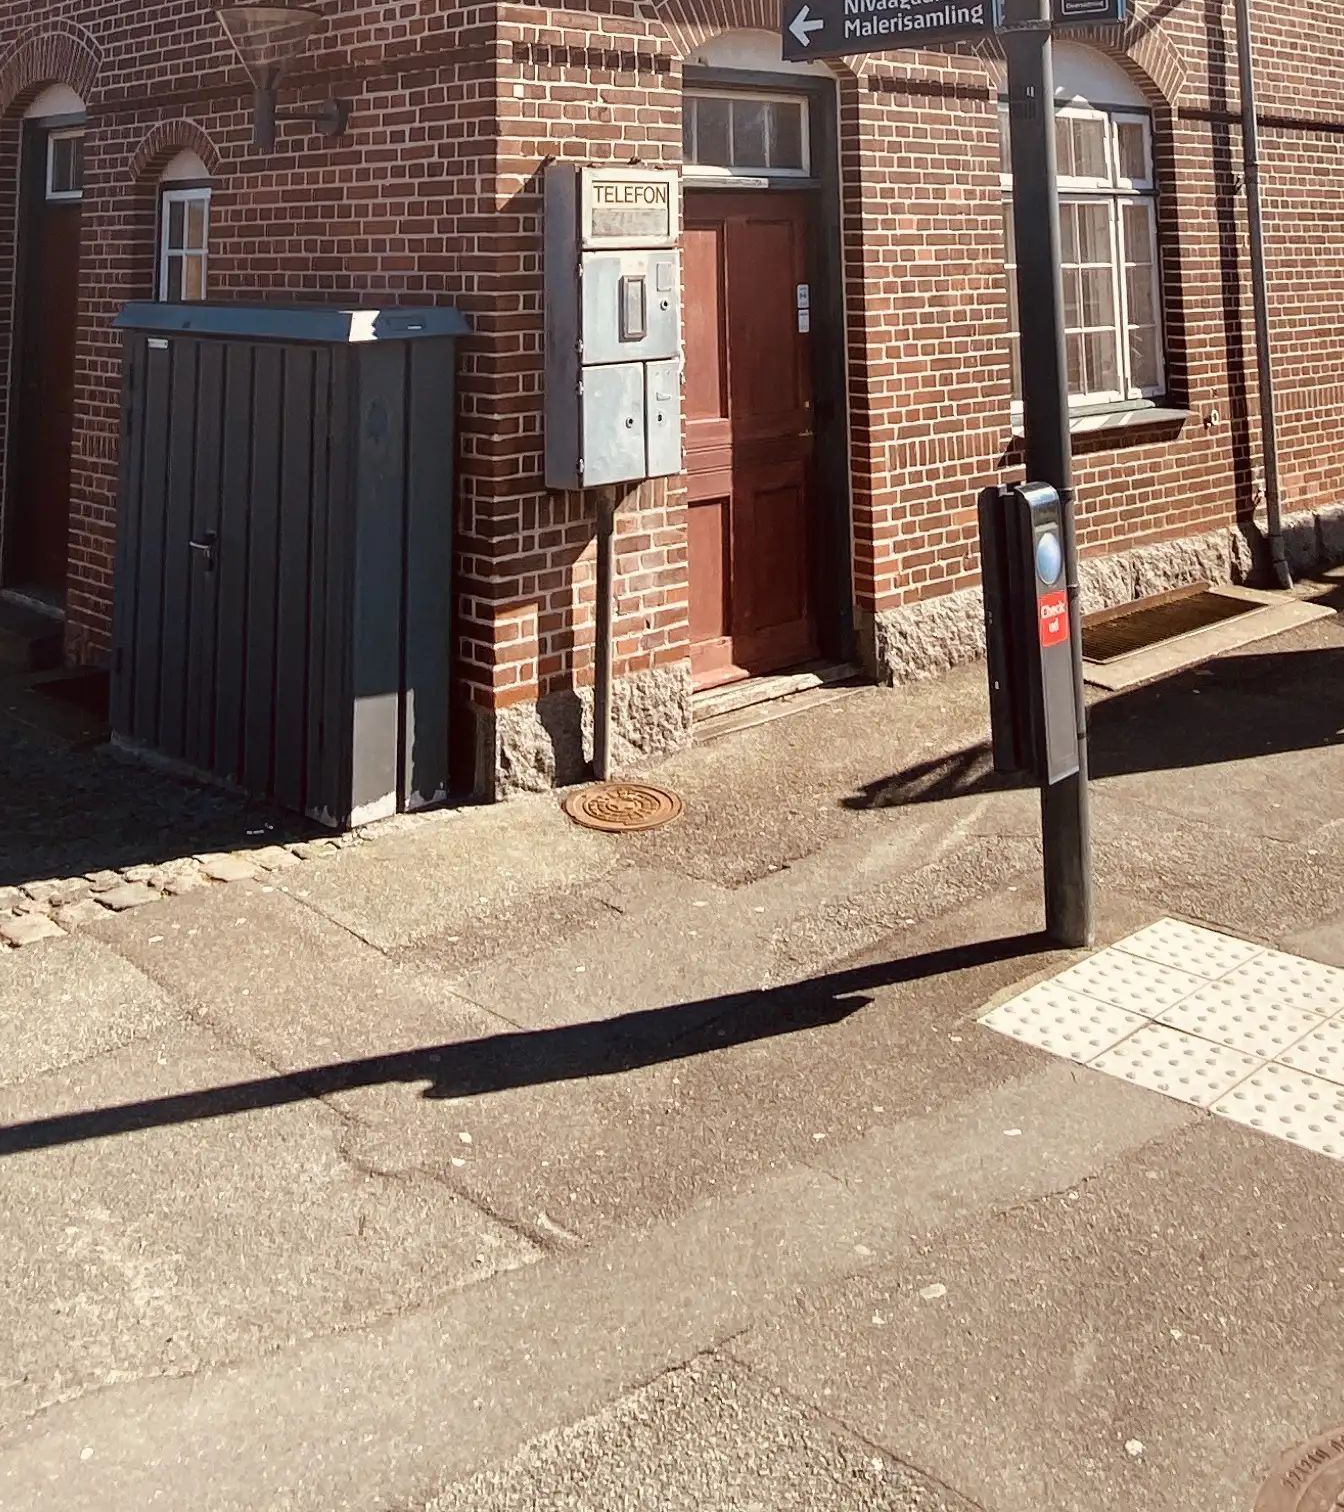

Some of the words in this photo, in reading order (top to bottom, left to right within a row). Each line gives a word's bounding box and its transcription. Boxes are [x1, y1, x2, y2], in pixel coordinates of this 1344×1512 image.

[844, 3, 984, 38] Malerisamling
[593, 185, 666, 204] TELEFON
[1041, 600, 1065, 619] Check
[1049, 617, 1059, 632] ud
